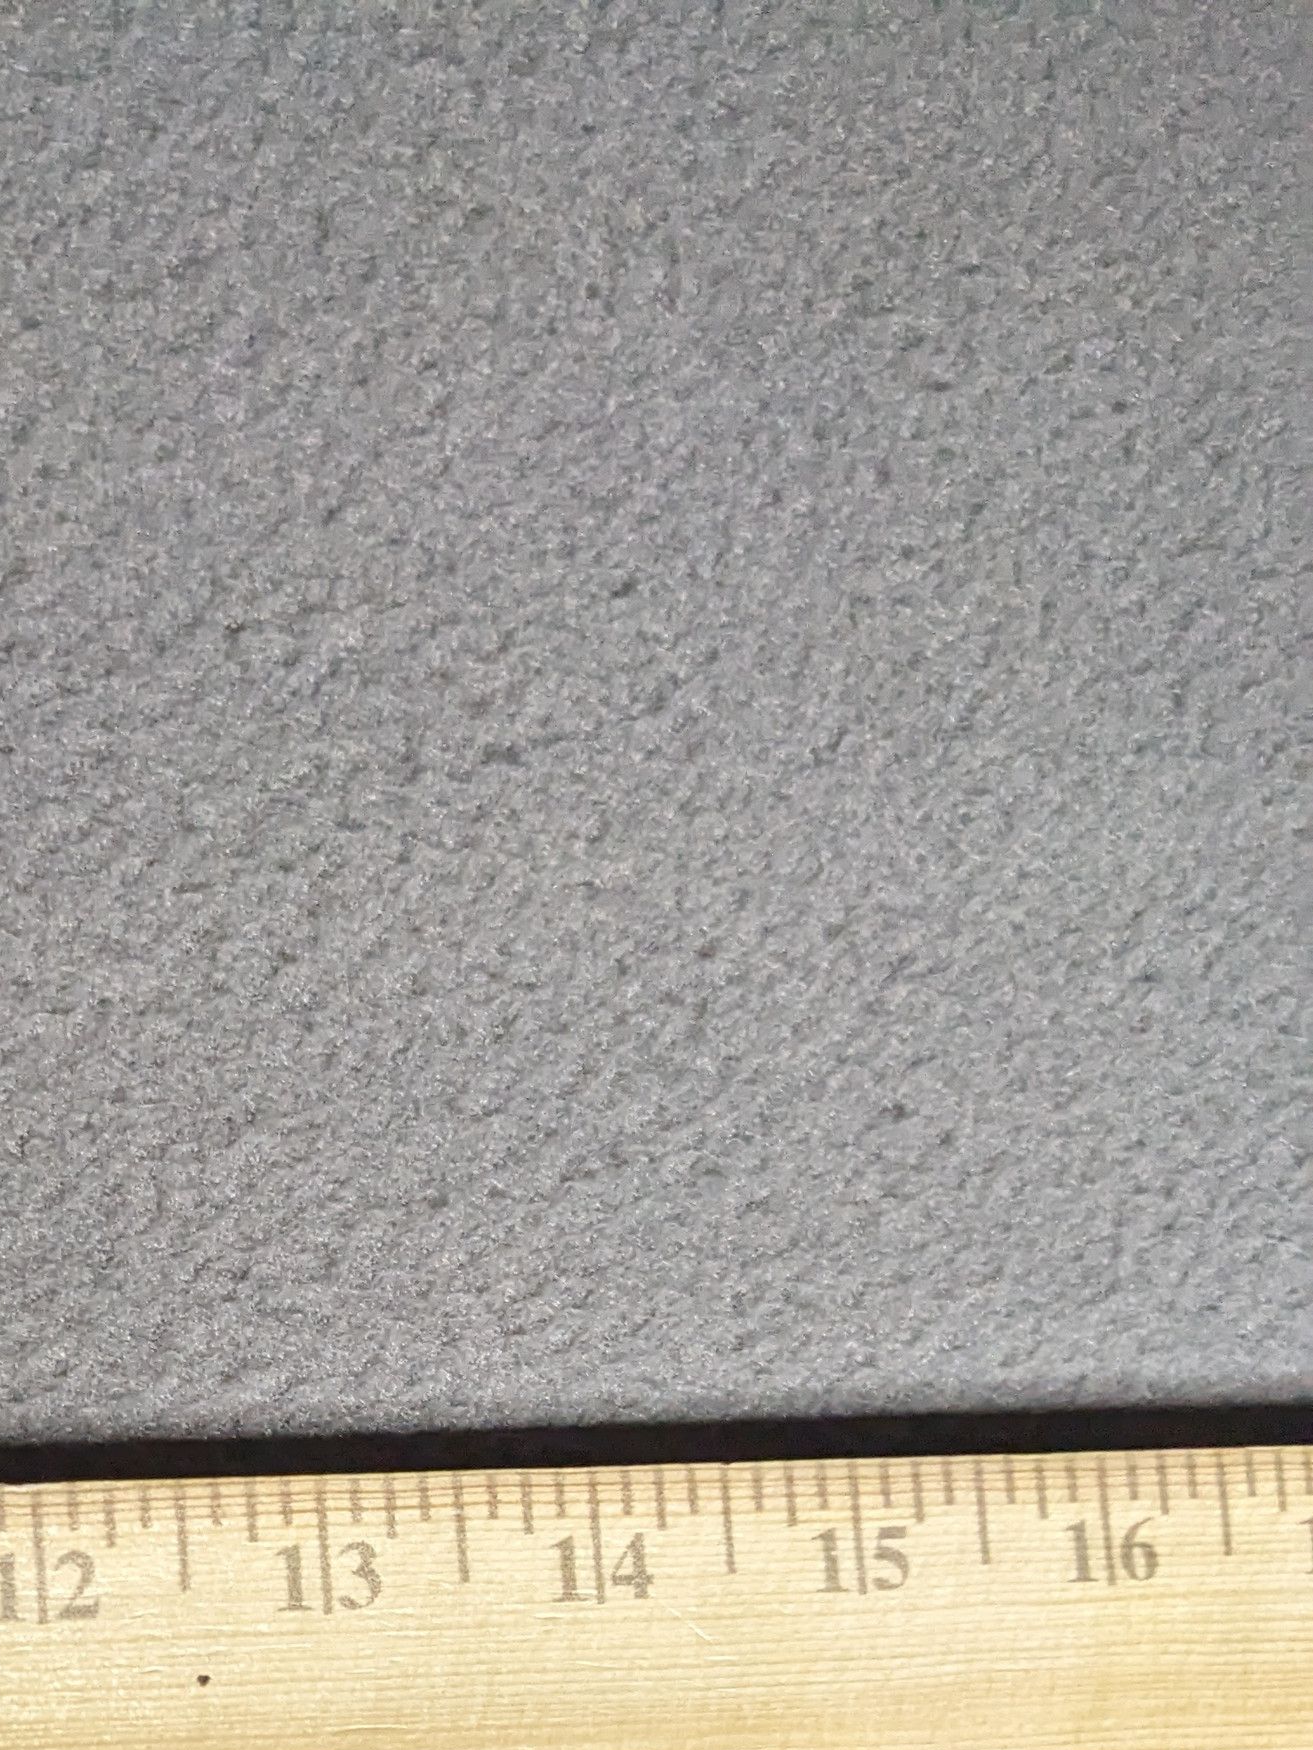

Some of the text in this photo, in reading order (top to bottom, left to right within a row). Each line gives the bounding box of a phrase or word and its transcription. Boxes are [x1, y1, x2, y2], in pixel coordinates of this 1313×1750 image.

[275, 1540, 383, 1613] 13
[553, 1532, 655, 1604] 14
[814, 1523, 911, 1594] 15
[1063, 1510, 1160, 1583] 16
